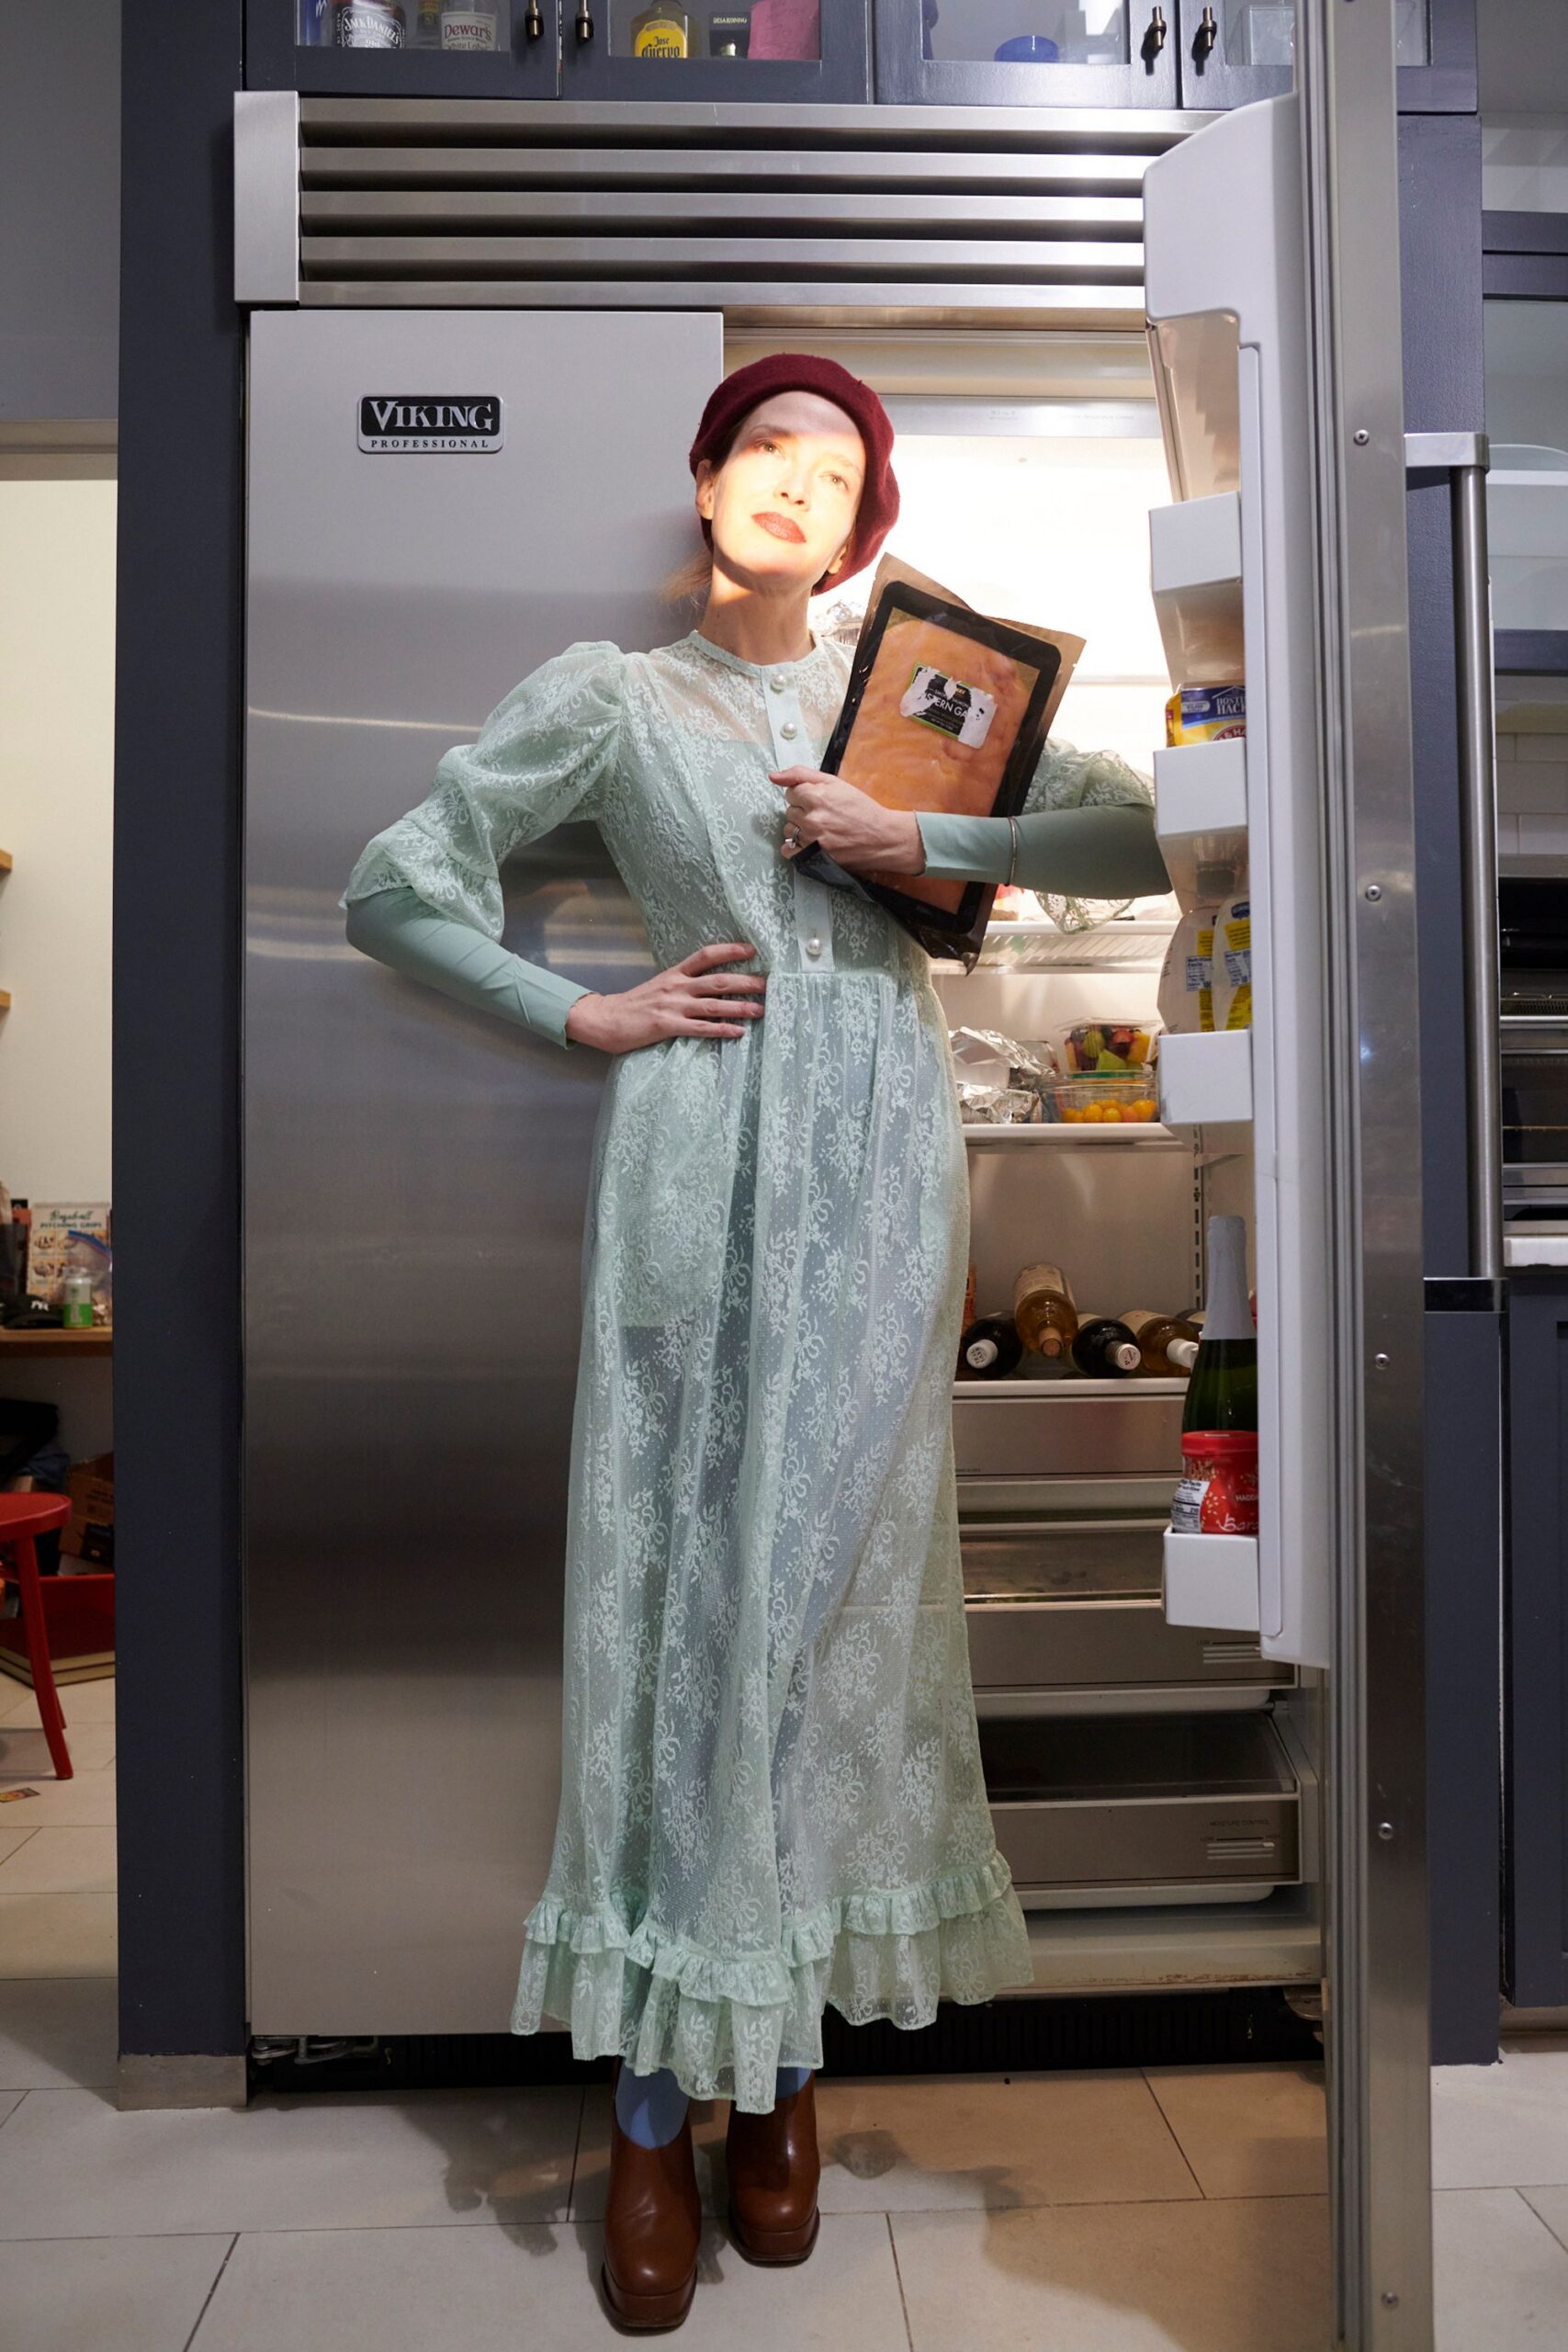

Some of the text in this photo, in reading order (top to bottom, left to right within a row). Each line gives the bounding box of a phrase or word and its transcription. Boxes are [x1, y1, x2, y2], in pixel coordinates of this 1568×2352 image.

[445, 24, 492, 41] Dewar's
[654, 36, 670, 47] Jose
[368, 400, 494, 432] VIKING
[371, 439, 489, 448] PROFESSIONAL
[927, 693, 953, 713] SERN
